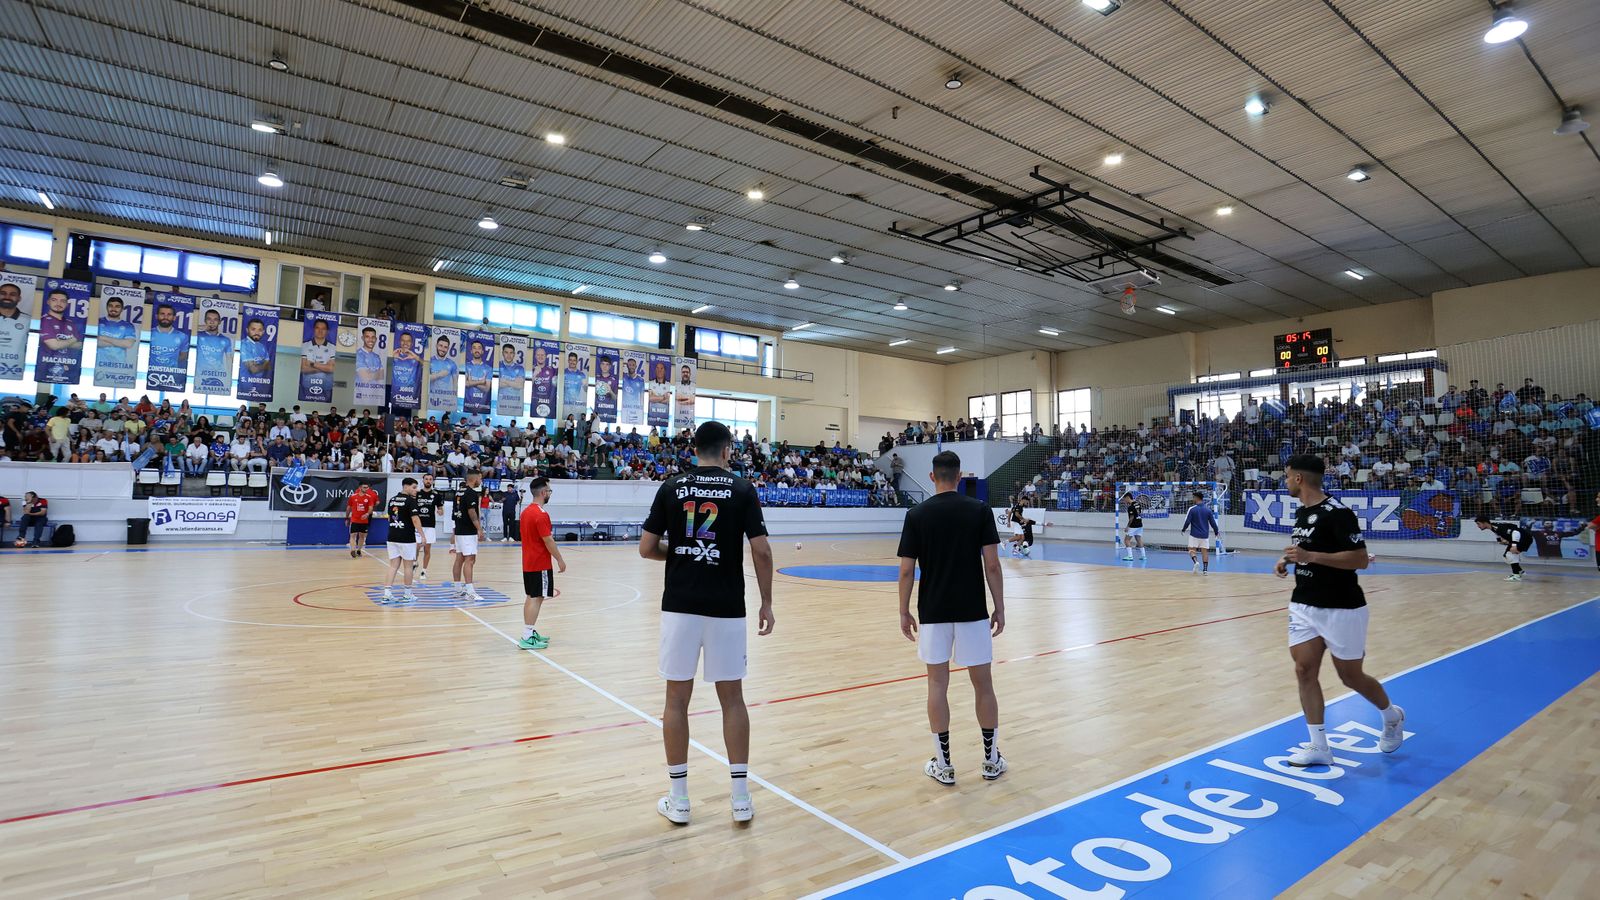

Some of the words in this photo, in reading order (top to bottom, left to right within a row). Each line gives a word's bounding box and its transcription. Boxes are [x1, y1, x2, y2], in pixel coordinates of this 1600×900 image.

[68, 299, 89, 318] 13
[124, 305, 144, 324] 12
[176, 311, 194, 330] 11
[220, 316, 238, 334] 10
[266, 324, 276, 342] 9
[378, 334, 387, 350] 8
[414, 338, 424, 354] 5
[450, 342, 458, 358] 6
[485, 346, 494, 361] 7
[516, 350, 524, 364] 3
[1280, 350, 1292, 360] 00
[1316, 346, 1328, 356] 00
[42, 356, 76, 365] MACARRO
[98, 361, 134, 369] CHRISTIAN
[546, 354, 559, 368] 15
[578, 358, 590, 372] 14
[612, 361, 618, 376] 1
[148, 364, 187, 374] CONSTANTINO
[637, 360, 646, 378] 4
[695, 475, 734, 484] TRANSTER
[683, 500, 718, 540] 12
[1251, 492, 1401, 532] XEEZ
[1125, 788, 1279, 844] de
